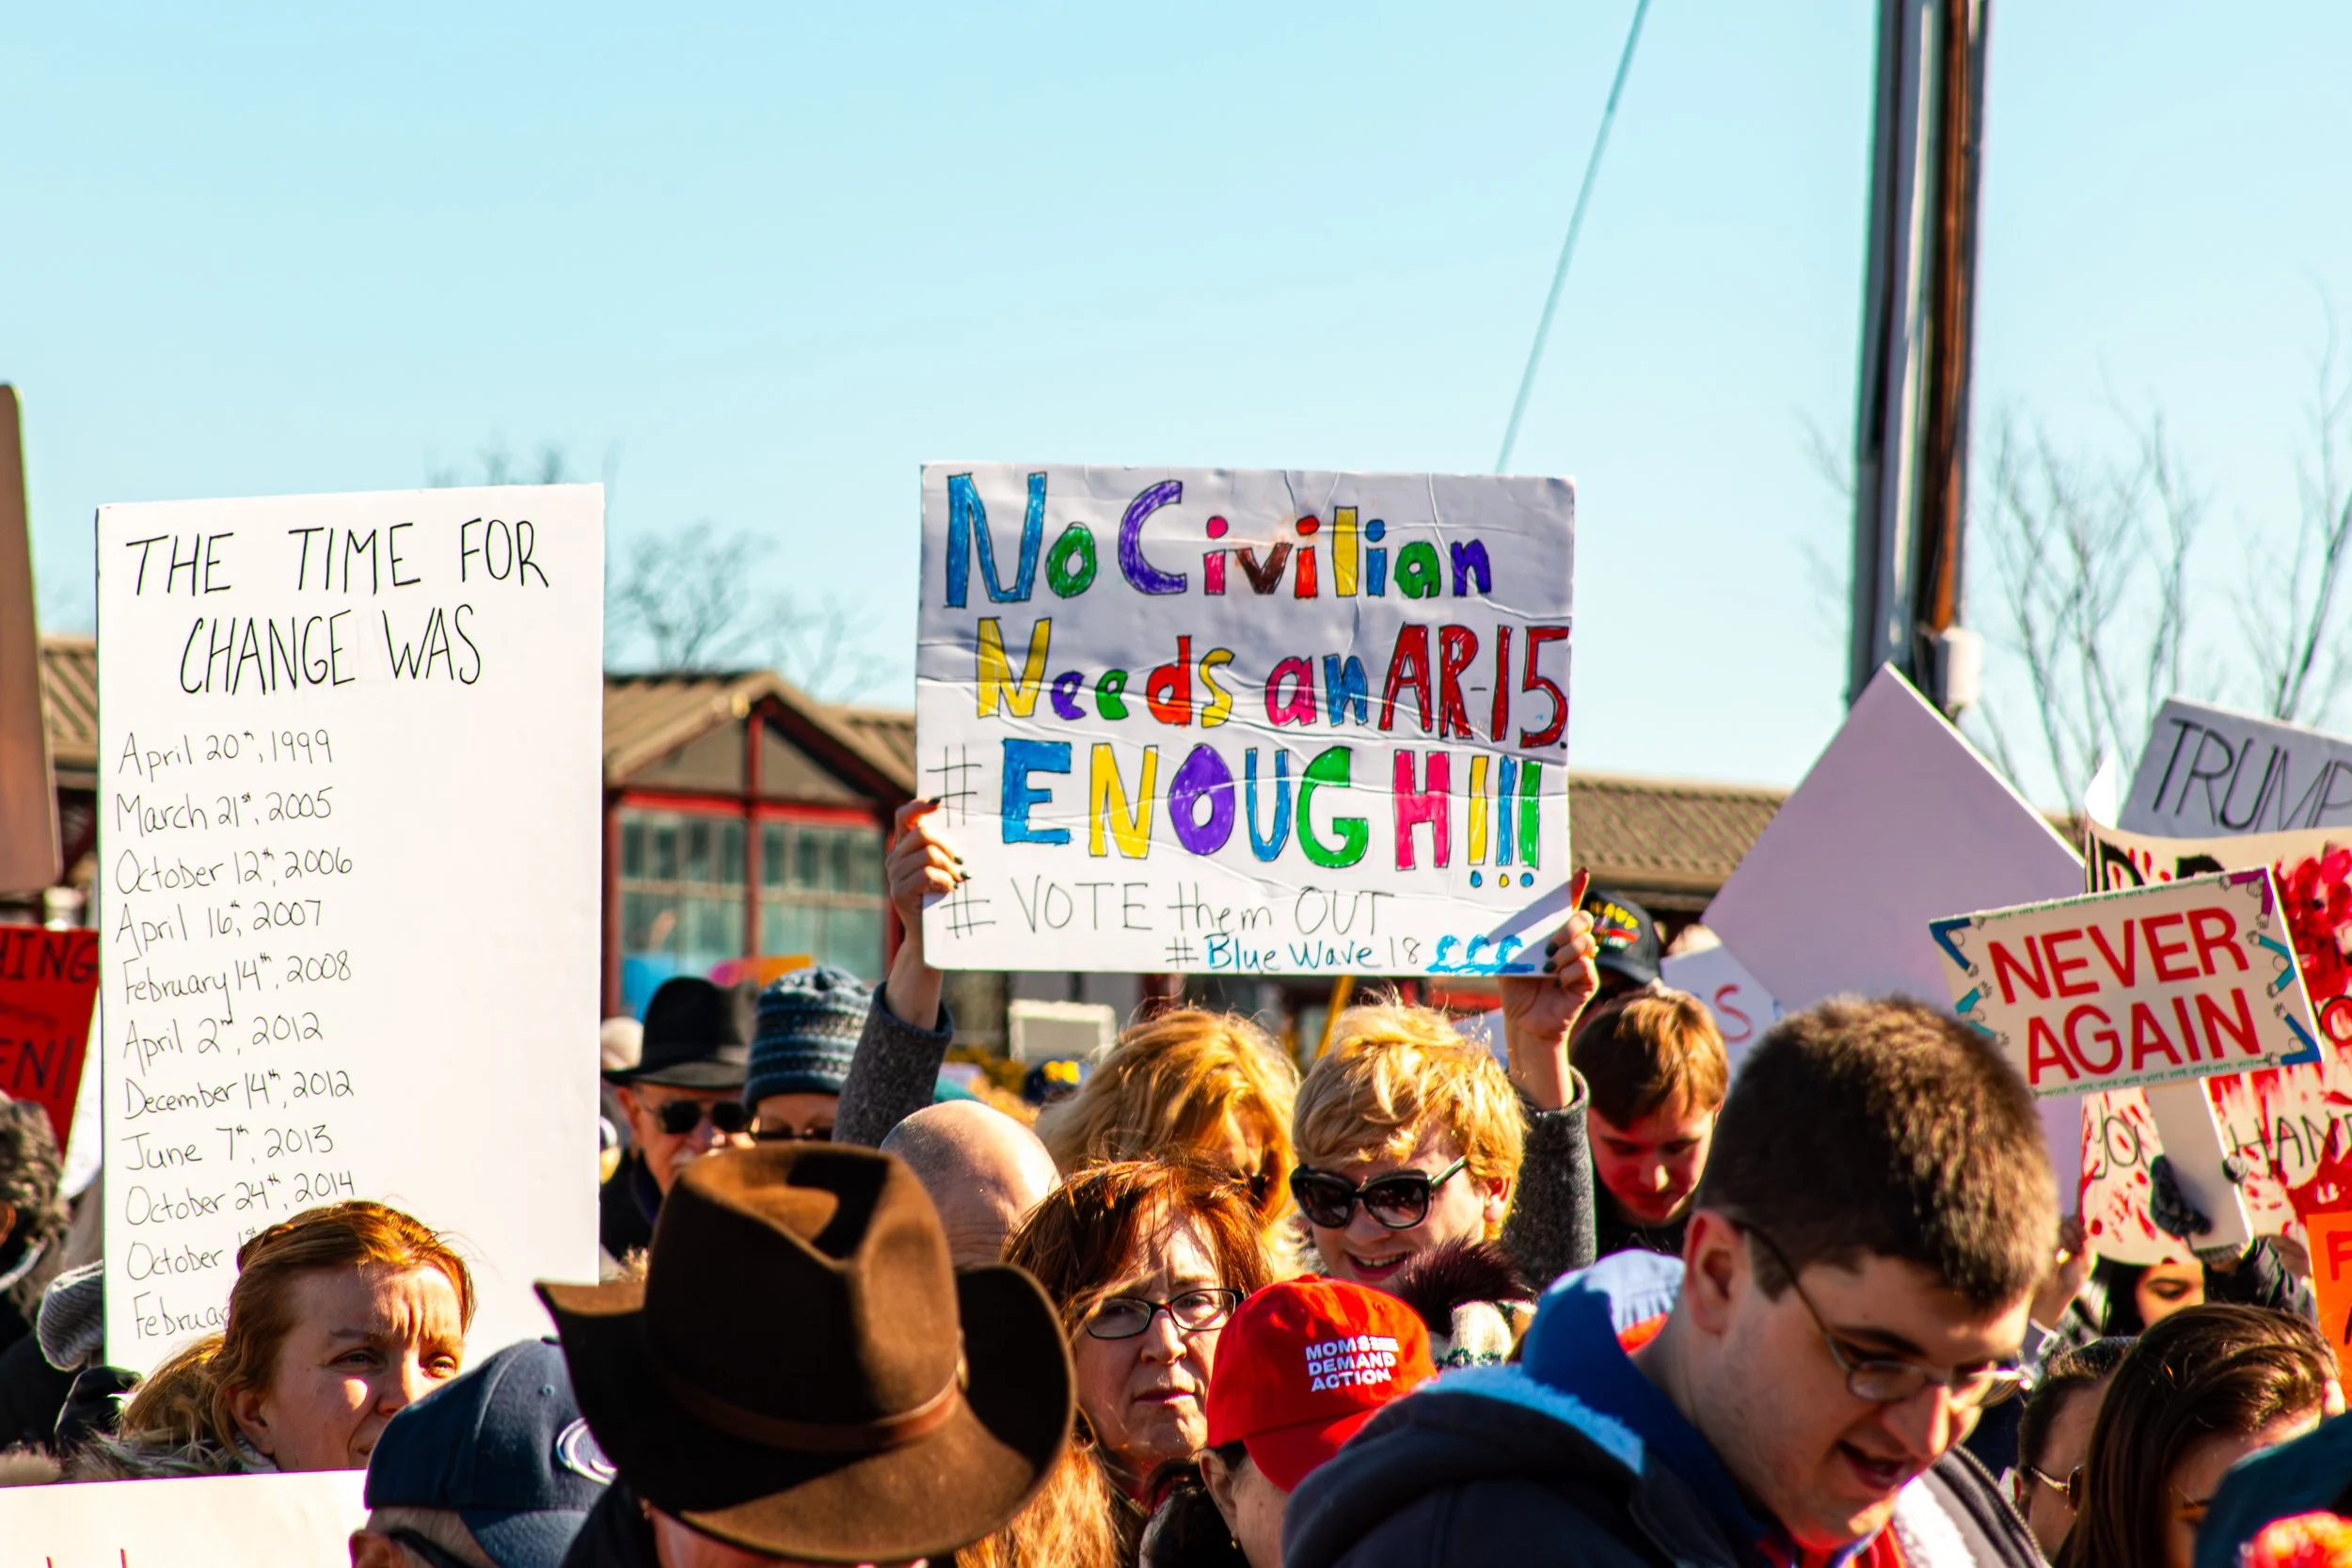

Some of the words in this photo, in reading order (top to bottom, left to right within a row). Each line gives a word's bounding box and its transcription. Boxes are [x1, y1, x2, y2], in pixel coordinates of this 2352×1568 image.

[126, 532, 234, 596] THE
[288, 522, 421, 594] TIME
[462, 517, 548, 588] FOR
[943, 471, 1098, 609] No
[1117, 479, 1493, 599] Civilian
[180, 610, 356, 695] CHANGE
[382, 604, 481, 685] WAS
[976, 616, 1235, 729] Needs
[1264, 654, 1369, 726] an
[119, 732, 193, 783] April
[272, 729, 333, 764] 1999
[116, 793, 207, 837] March
[266, 786, 333, 820] 2005
[115, 848, 223, 895] October
[285, 846, 353, 880] 2006
[116, 904, 187, 956] April
[252, 899, 322, 928] 2007
[1168, 880, 1272, 934] them
[1295, 884, 1394, 936] OUT
[0, 927, 98, 984] ING
[123, 955, 231, 1016] February
[287, 950, 352, 983] 2008
[1987, 907, 2249, 1005] NEVER
[123, 1018, 183, 1075] April
[252, 1012, 324, 1045] 2012
[2028, 987, 2261, 1086] AGAIN
[123, 1078, 236, 1119] December
[293, 1070, 354, 1099] 2012
[121, 1132, 203, 1170] June
[264, 1124, 333, 1159] 2013
[126, 1186, 225, 1226] October
[294, 1170, 356, 1197] 2014
[127, 1242, 223, 1280] October
[1305, 1335, 1371, 1361] MOMS
[1308, 1352, 1396, 1376] DEMAND
[1311, 1367, 1391, 1392] ACTION
